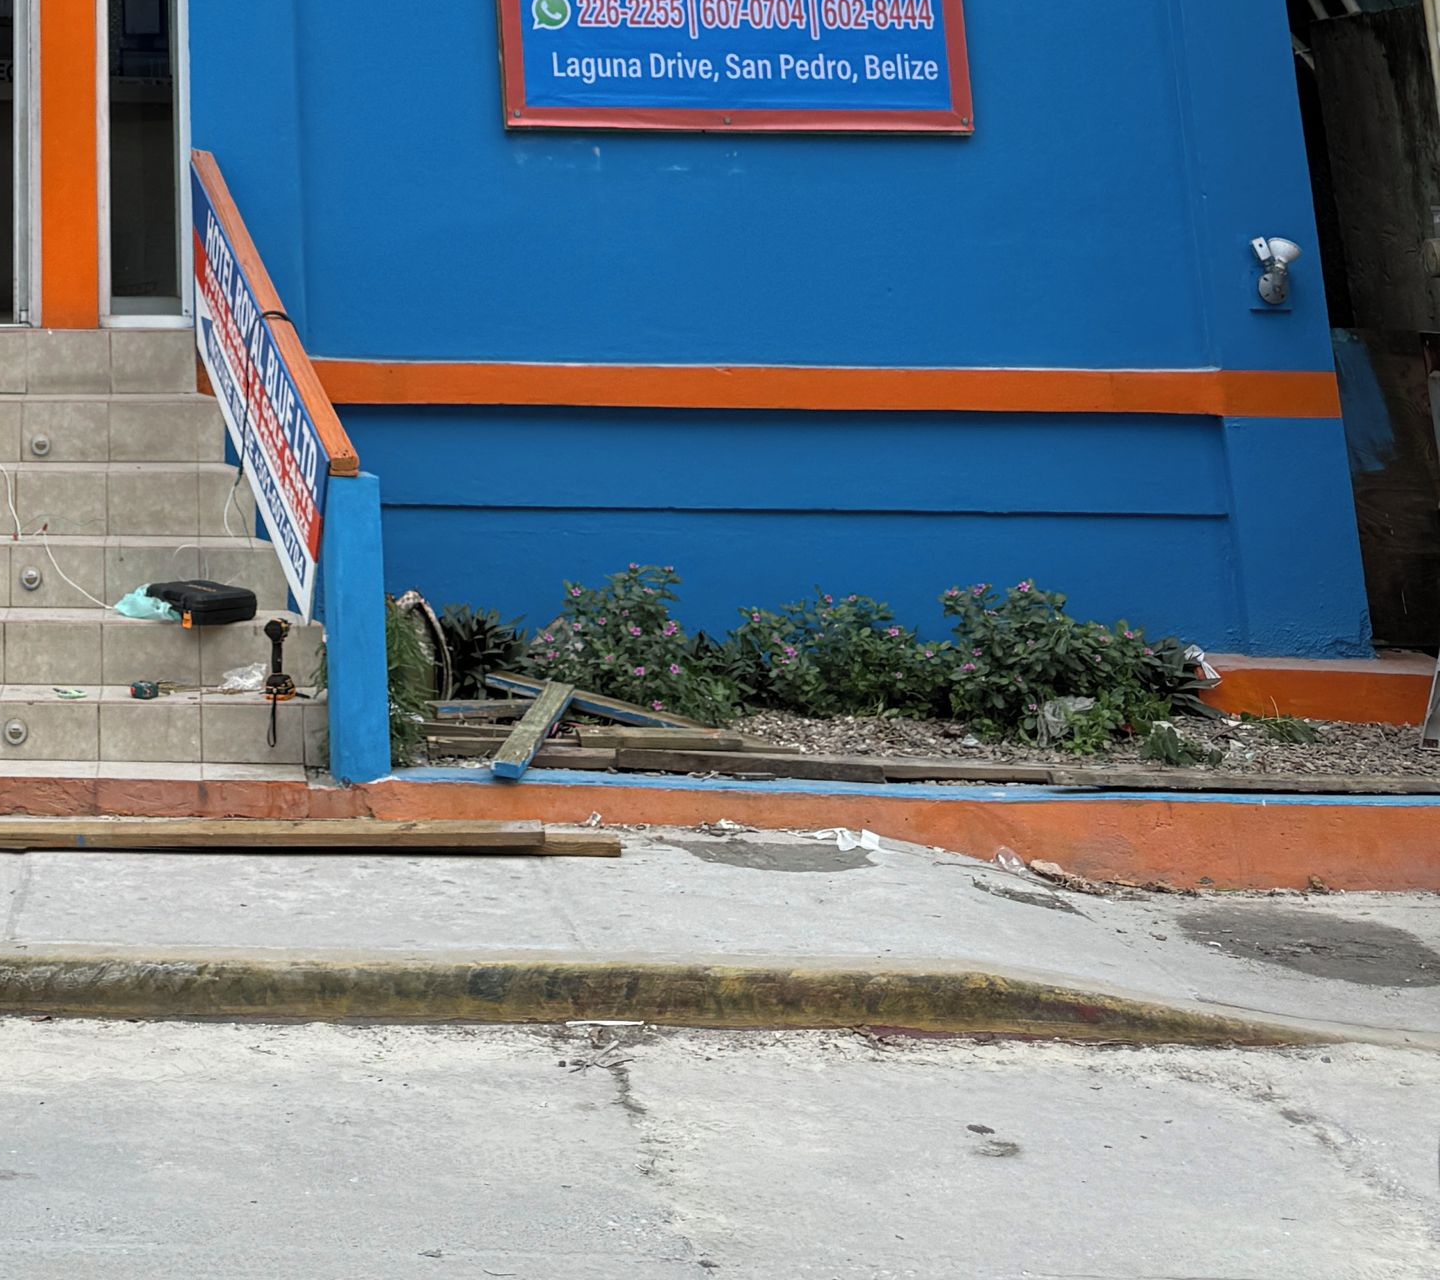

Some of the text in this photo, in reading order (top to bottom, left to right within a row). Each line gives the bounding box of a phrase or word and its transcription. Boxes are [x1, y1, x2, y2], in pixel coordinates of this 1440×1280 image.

[552, 52, 939, 84] Laguna Drive, San Pedro, Belize
[205, 209, 318, 502] HOTEL ROYAL BLUE LTD.
[261, 394, 285, 450] GOLF
[284, 447, 313, 523] CARTS
